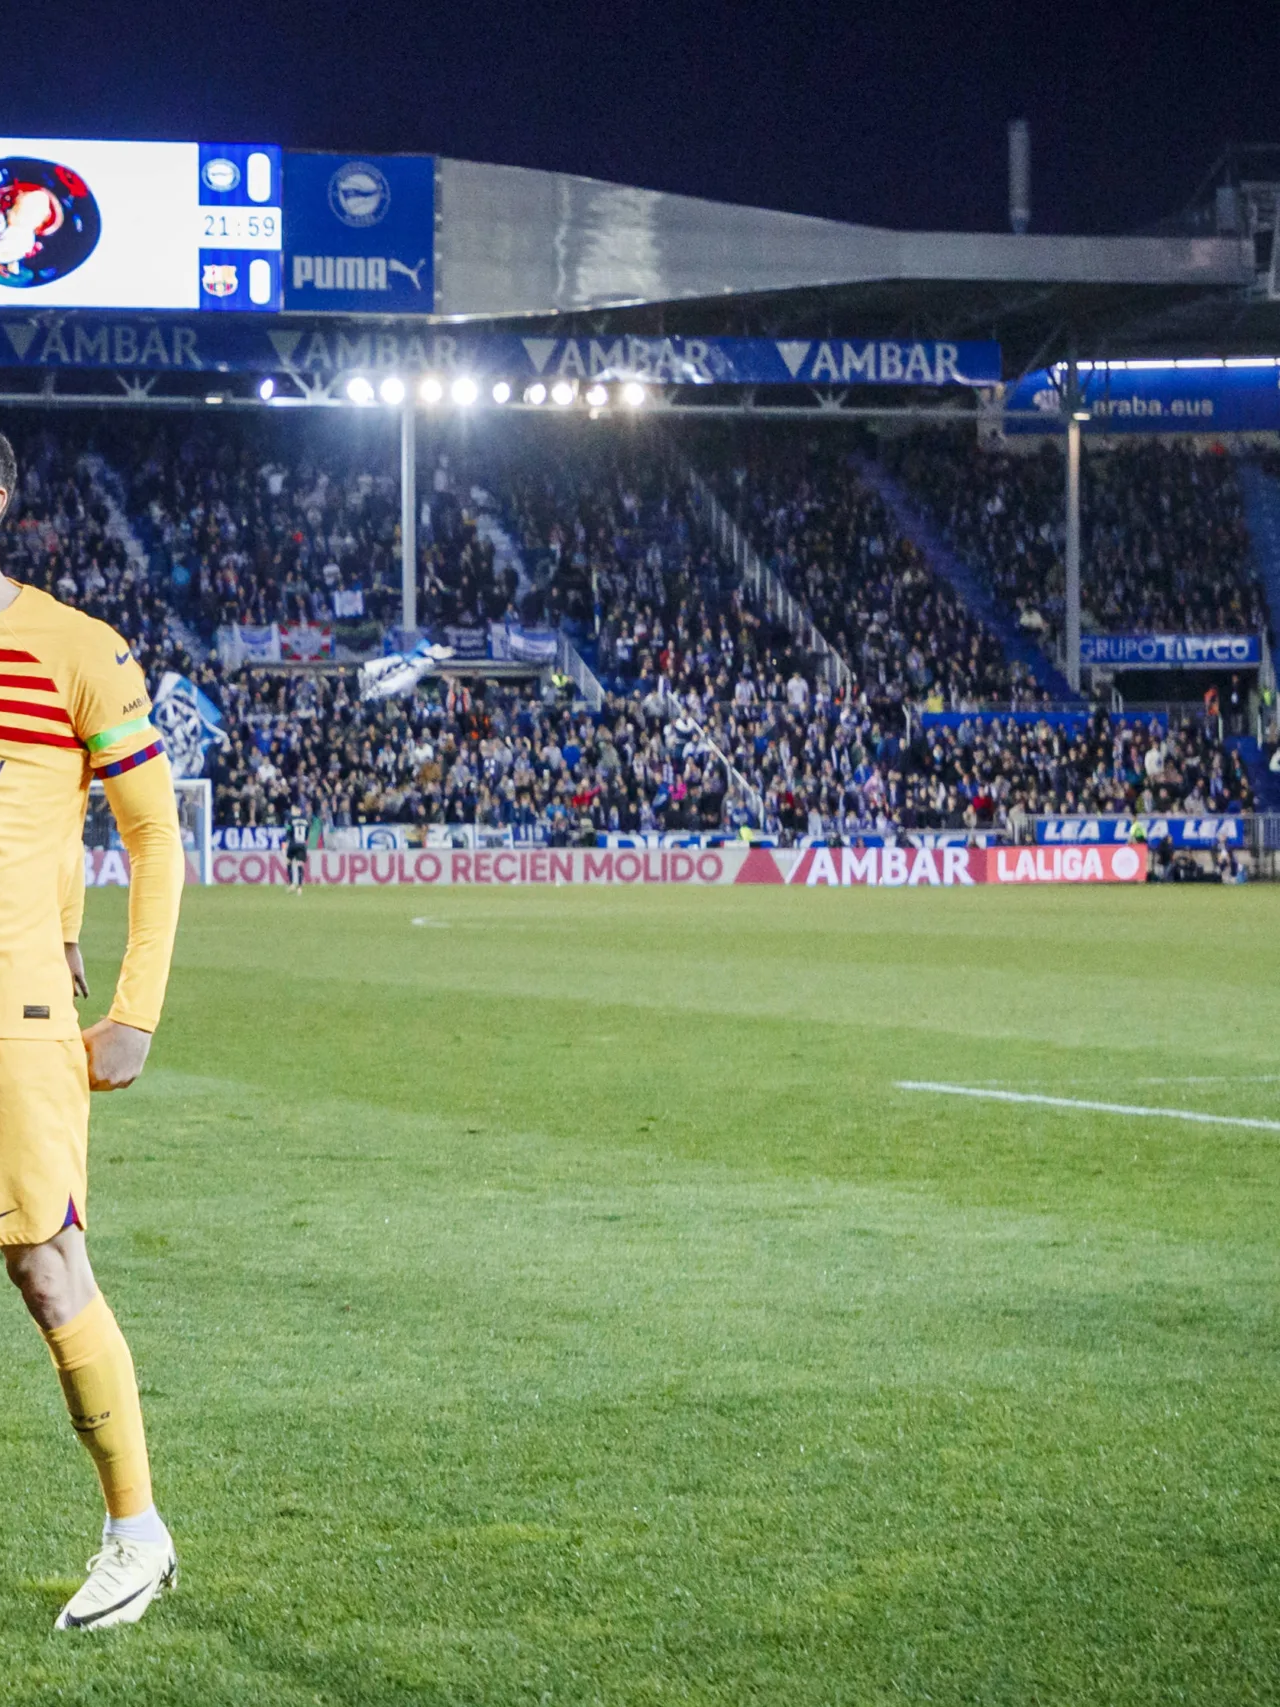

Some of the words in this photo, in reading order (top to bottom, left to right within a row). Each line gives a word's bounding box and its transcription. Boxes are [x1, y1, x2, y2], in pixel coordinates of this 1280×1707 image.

[204, 214, 275, 237] 21:59
[293, 255, 388, 291] PUMA
[38, 326, 204, 366] AMBAR
[304, 333, 460, 370] AMBAR
[557, 338, 712, 380] AMBAR
[808, 340, 963, 382] AMBAR
[1080, 638, 1156, 660] GRUPO
[1044, 819, 1100, 841] LEA
[1114, 819, 1169, 841] LA
[1182, 819, 1238, 840] LEA
[583, 851, 723, 883] MOLIDO
[806, 846, 976, 887] AMBAR
[997, 847, 1103, 881] LALIGA
